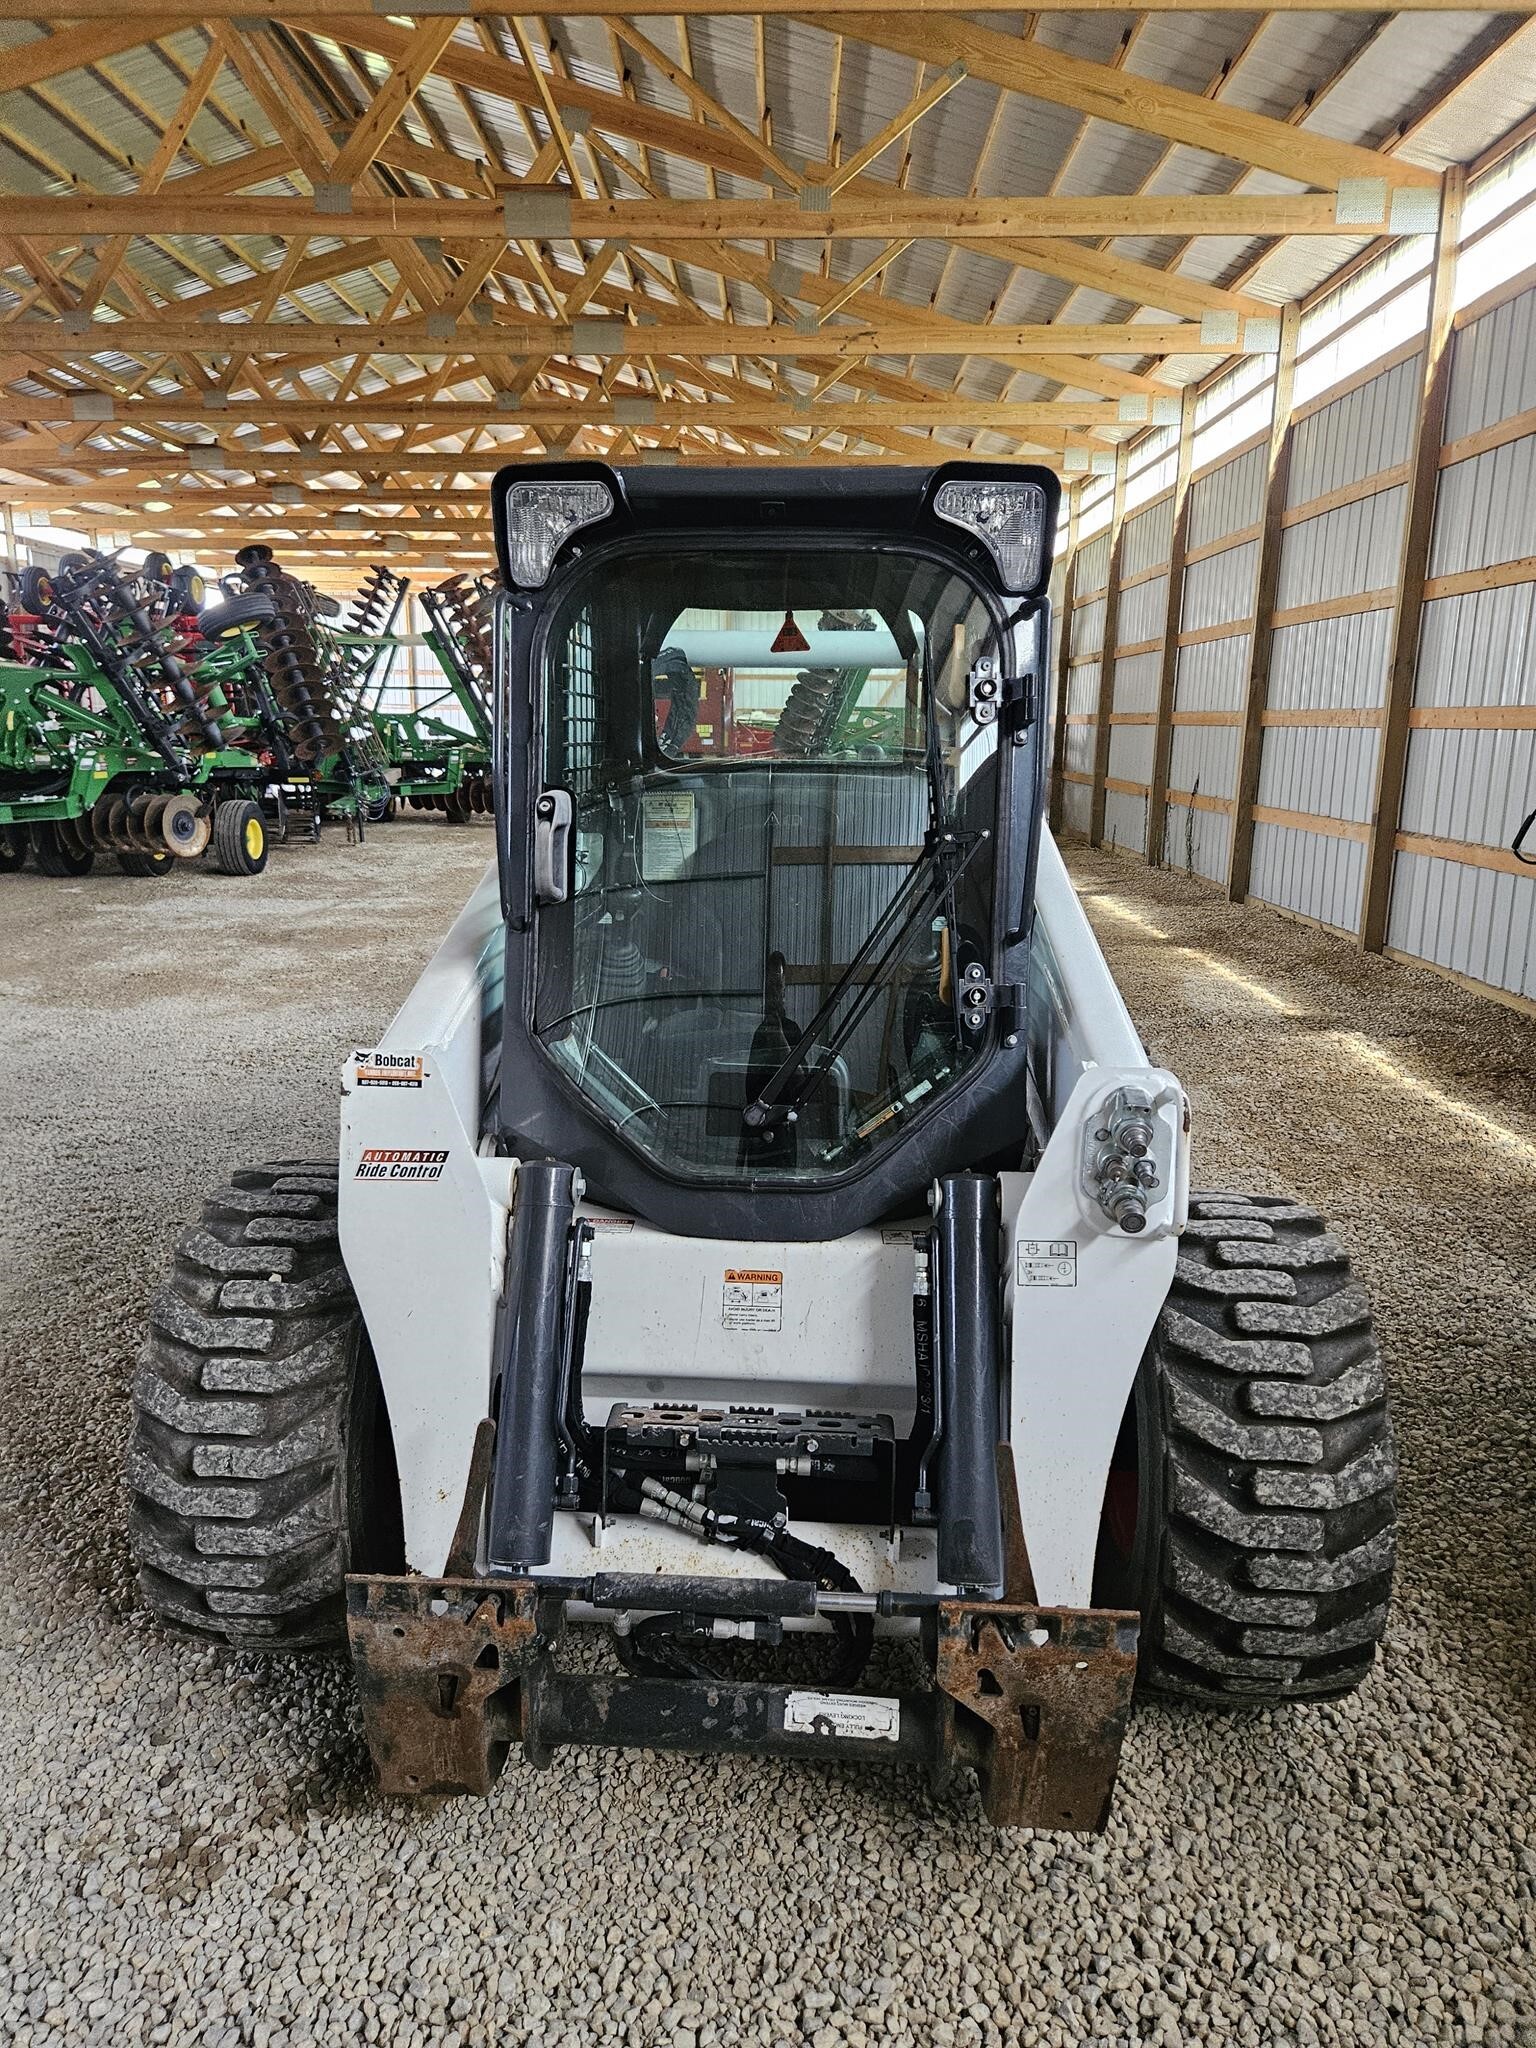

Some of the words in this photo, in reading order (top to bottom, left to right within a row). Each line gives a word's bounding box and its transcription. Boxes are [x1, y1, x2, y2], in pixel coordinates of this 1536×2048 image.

[375, 1054, 415, 1068] Bobcat
[364, 1151, 444, 1162] AUTOMATIC
[355, 1163, 387, 1177] Ride
[390, 1164, 444, 1178] Control
[737, 1273, 778, 1281] WARNING
[916, 1320, 929, 1361] MSHA
